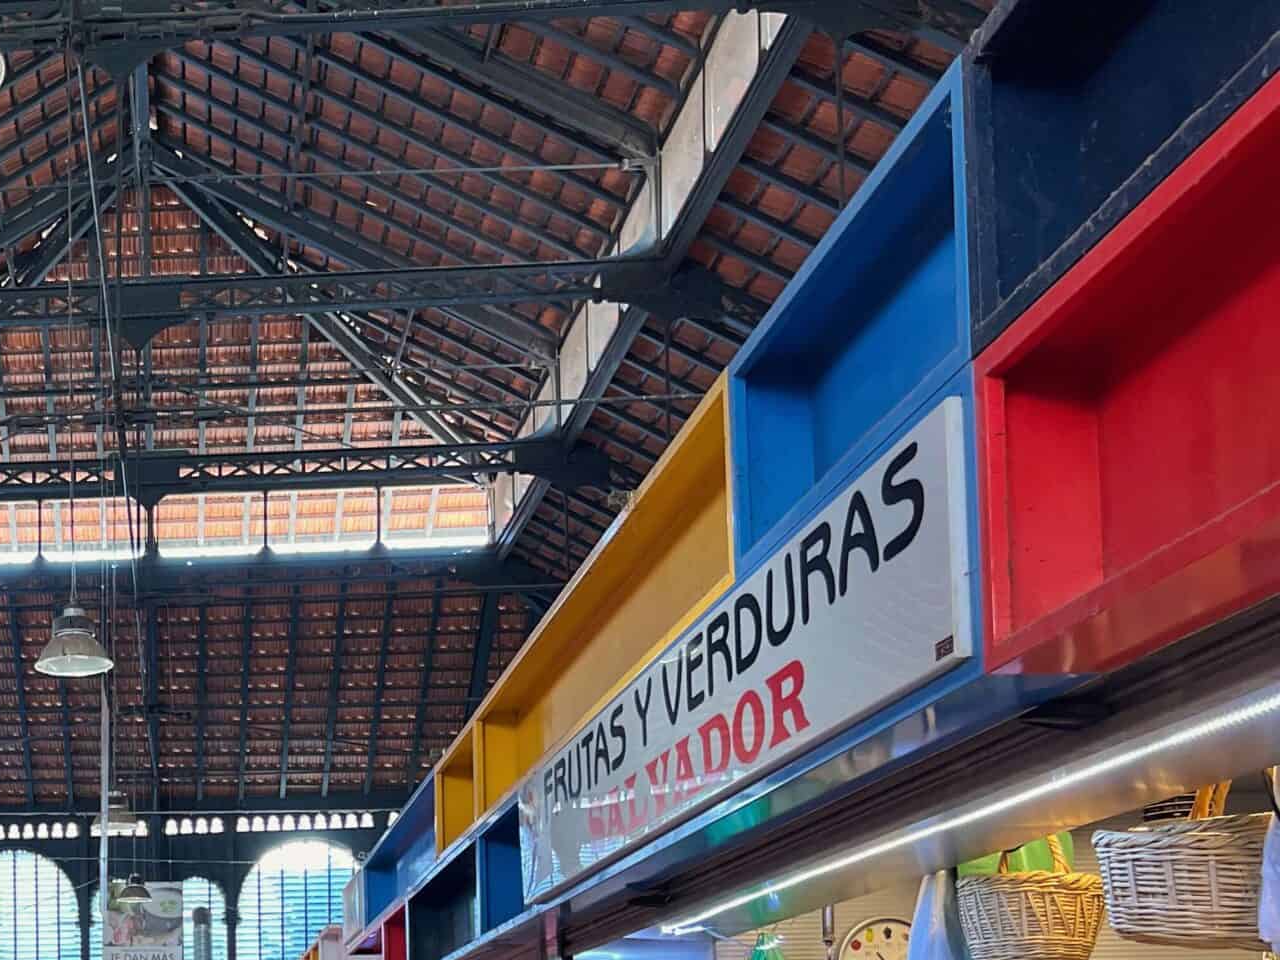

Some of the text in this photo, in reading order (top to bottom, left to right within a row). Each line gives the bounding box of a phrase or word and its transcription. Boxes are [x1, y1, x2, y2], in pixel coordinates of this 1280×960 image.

[543, 441, 925, 811] FRUTAS Y VERDURAS
[587, 660, 811, 838] SALVADOR
